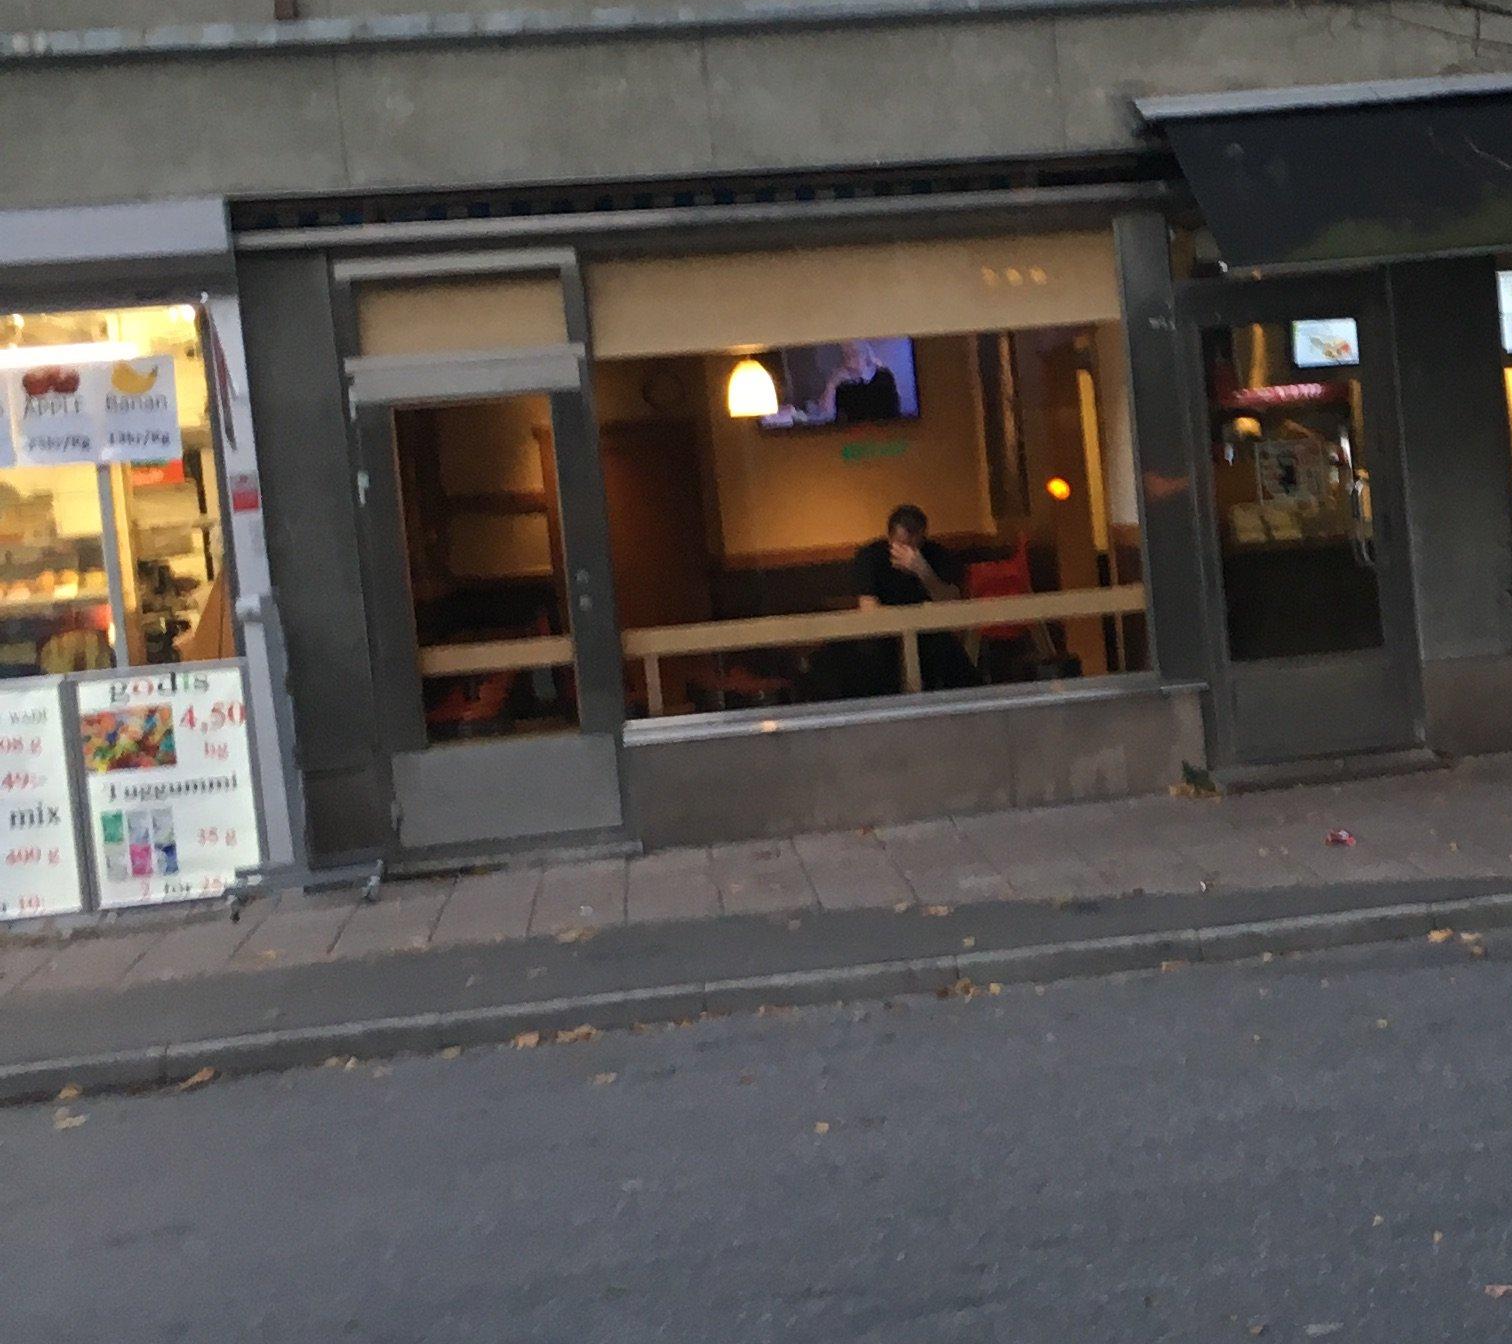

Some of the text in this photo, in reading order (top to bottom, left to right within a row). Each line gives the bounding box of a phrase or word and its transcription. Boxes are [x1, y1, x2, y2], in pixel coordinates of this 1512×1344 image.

[110, 672, 209, 705] godis
[179, 700, 247, 734] 4,50
[9, 801, 61, 830] mix
